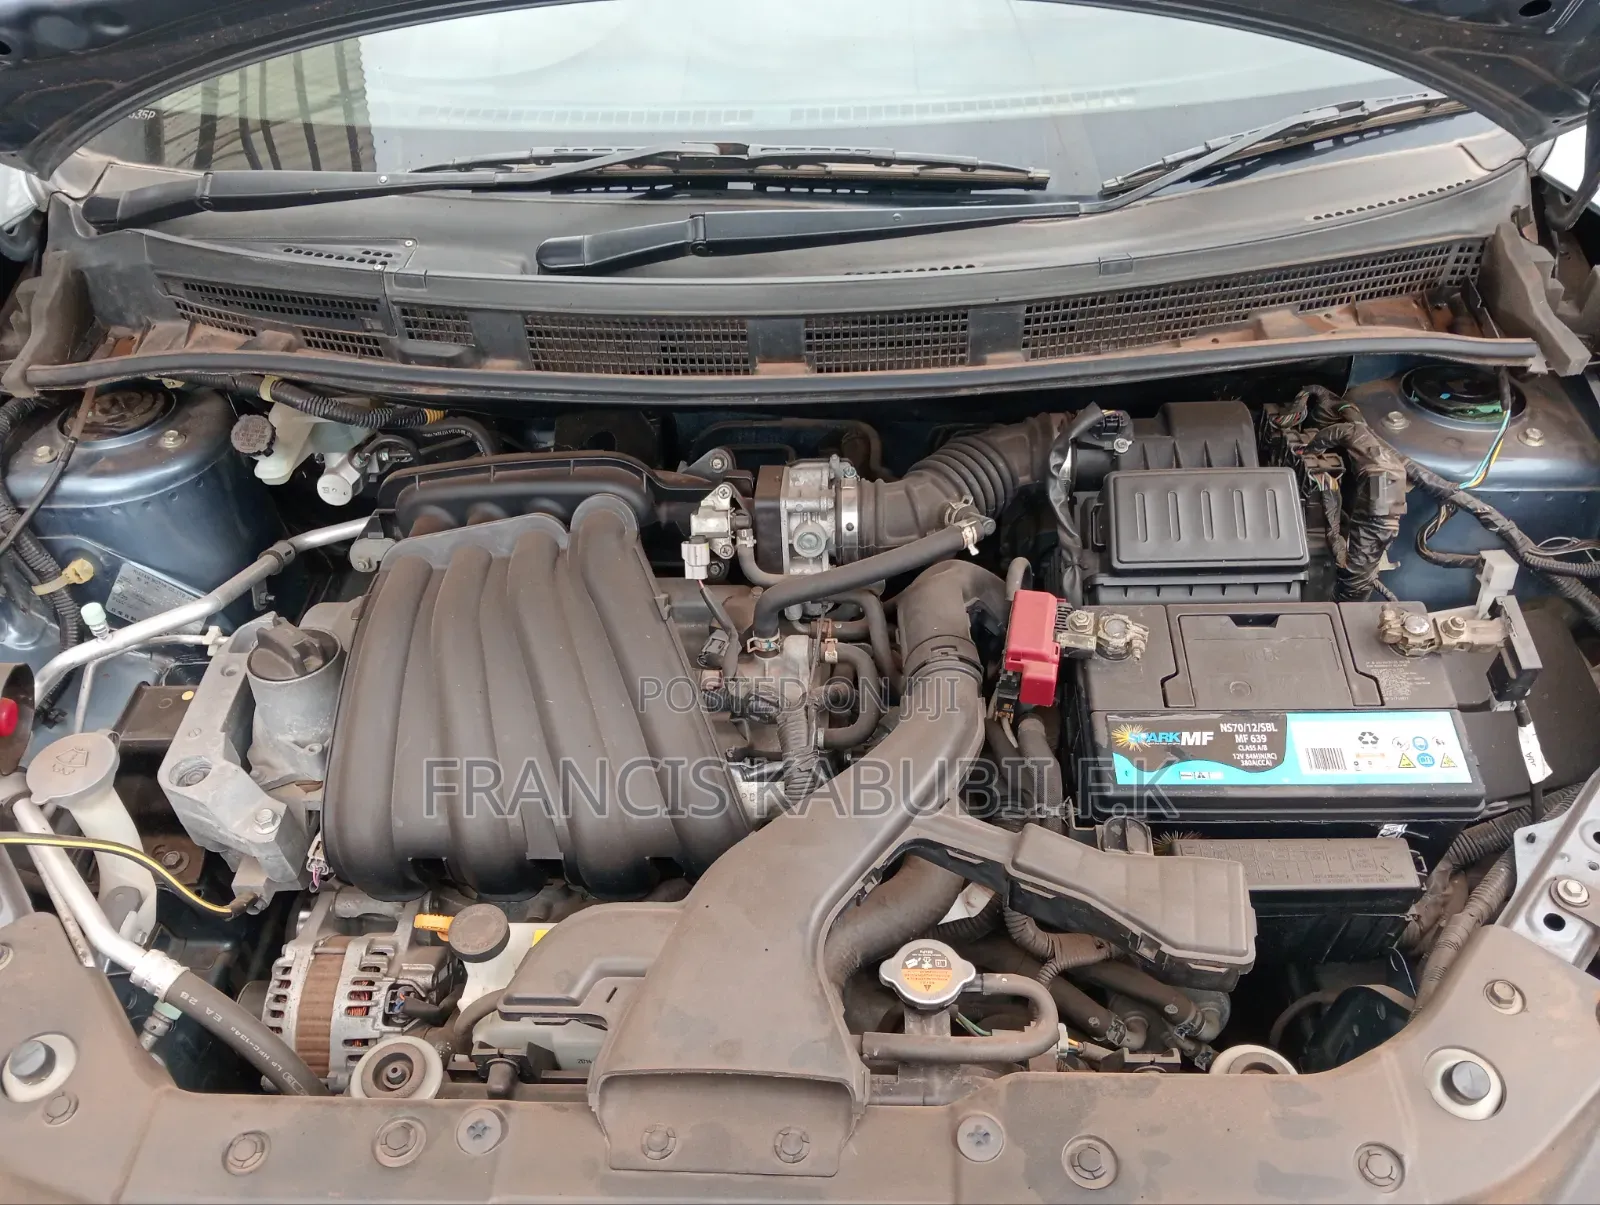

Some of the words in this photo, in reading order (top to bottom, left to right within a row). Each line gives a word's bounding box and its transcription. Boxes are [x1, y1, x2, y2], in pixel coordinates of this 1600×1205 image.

[1234, 734, 1249, 744] MF
[1250, 734, 1267, 744] 639
[1237, 744, 1256, 752] CLASS
